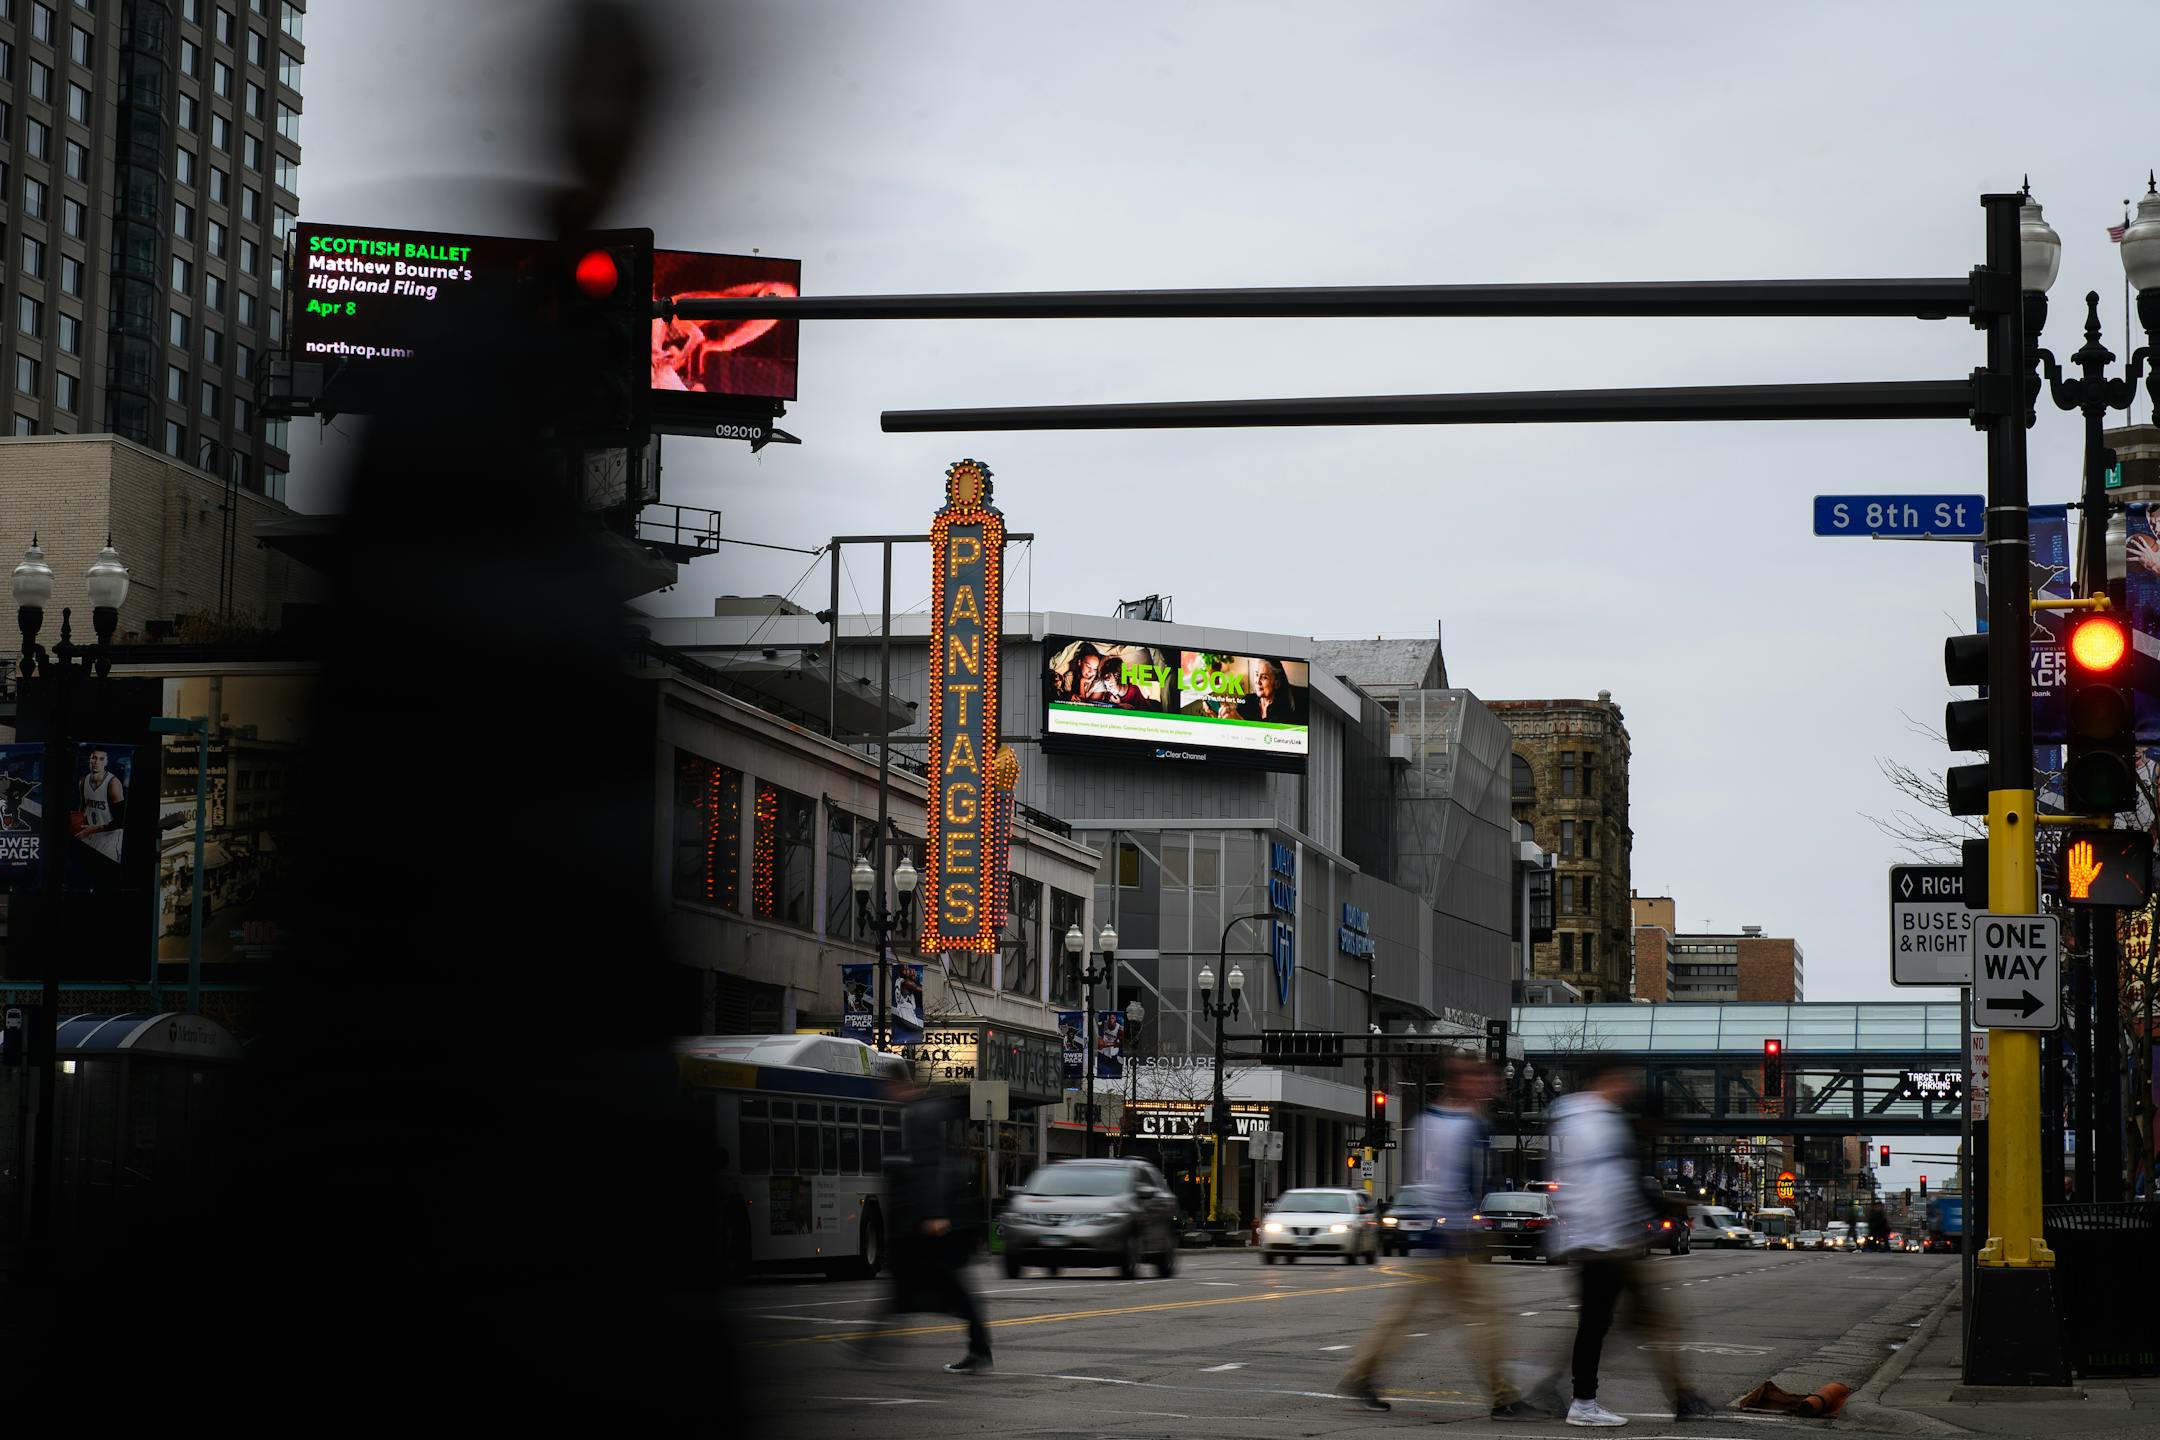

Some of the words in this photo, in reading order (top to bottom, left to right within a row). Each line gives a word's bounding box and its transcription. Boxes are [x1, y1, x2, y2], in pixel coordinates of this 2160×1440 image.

[309, 236, 400, 257] SCOTTISH
[404, 243, 472, 263] BALLET
[308, 255, 390, 275] Matthew
[394, 261, 473, 281] Bourne's
[308, 274, 390, 294] Highland
[393, 279, 438, 301] Fling
[306, 299, 341, 317] Apr
[345, 302, 357, 316] 8
[715, 424, 762, 440] 092010
[1832, 503, 1850, 528] S
[1865, 503, 1919, 528] 8th
[1934, 503, 1966, 528] St
[1121, 663, 1172, 689] HEY
[1177, 667, 1245, 696] LOOK
[944, 536, 983, 925] PANTAGES
[1165, 750, 1182, 759] Clear
[1182, 751, 1207, 761] Channel
[0, 848, 40, 860] PACK
[1922, 876, 1963, 895] RIGH
[1903, 912, 1971, 930] BUSES
[1985, 922, 2047, 949] ONE
[1984, 955, 2047, 981] WAY
[844, 1014, 873, 1024] POWER
[925, 1033, 978, 1044] ESENTS
[1973, 1037, 1984, 1050] NO
[945, 1066, 952, 1078] 8
[955, 1066, 975, 1078] PM
[1146, 1056, 1216, 1071] SQUARE
[1907, 1072, 1941, 1082] TARGET
[1944, 1073, 1962, 1082] CTR
[1917, 1081, 1951, 1090] PARKING
[1142, 1117, 1198, 1134] CITY
